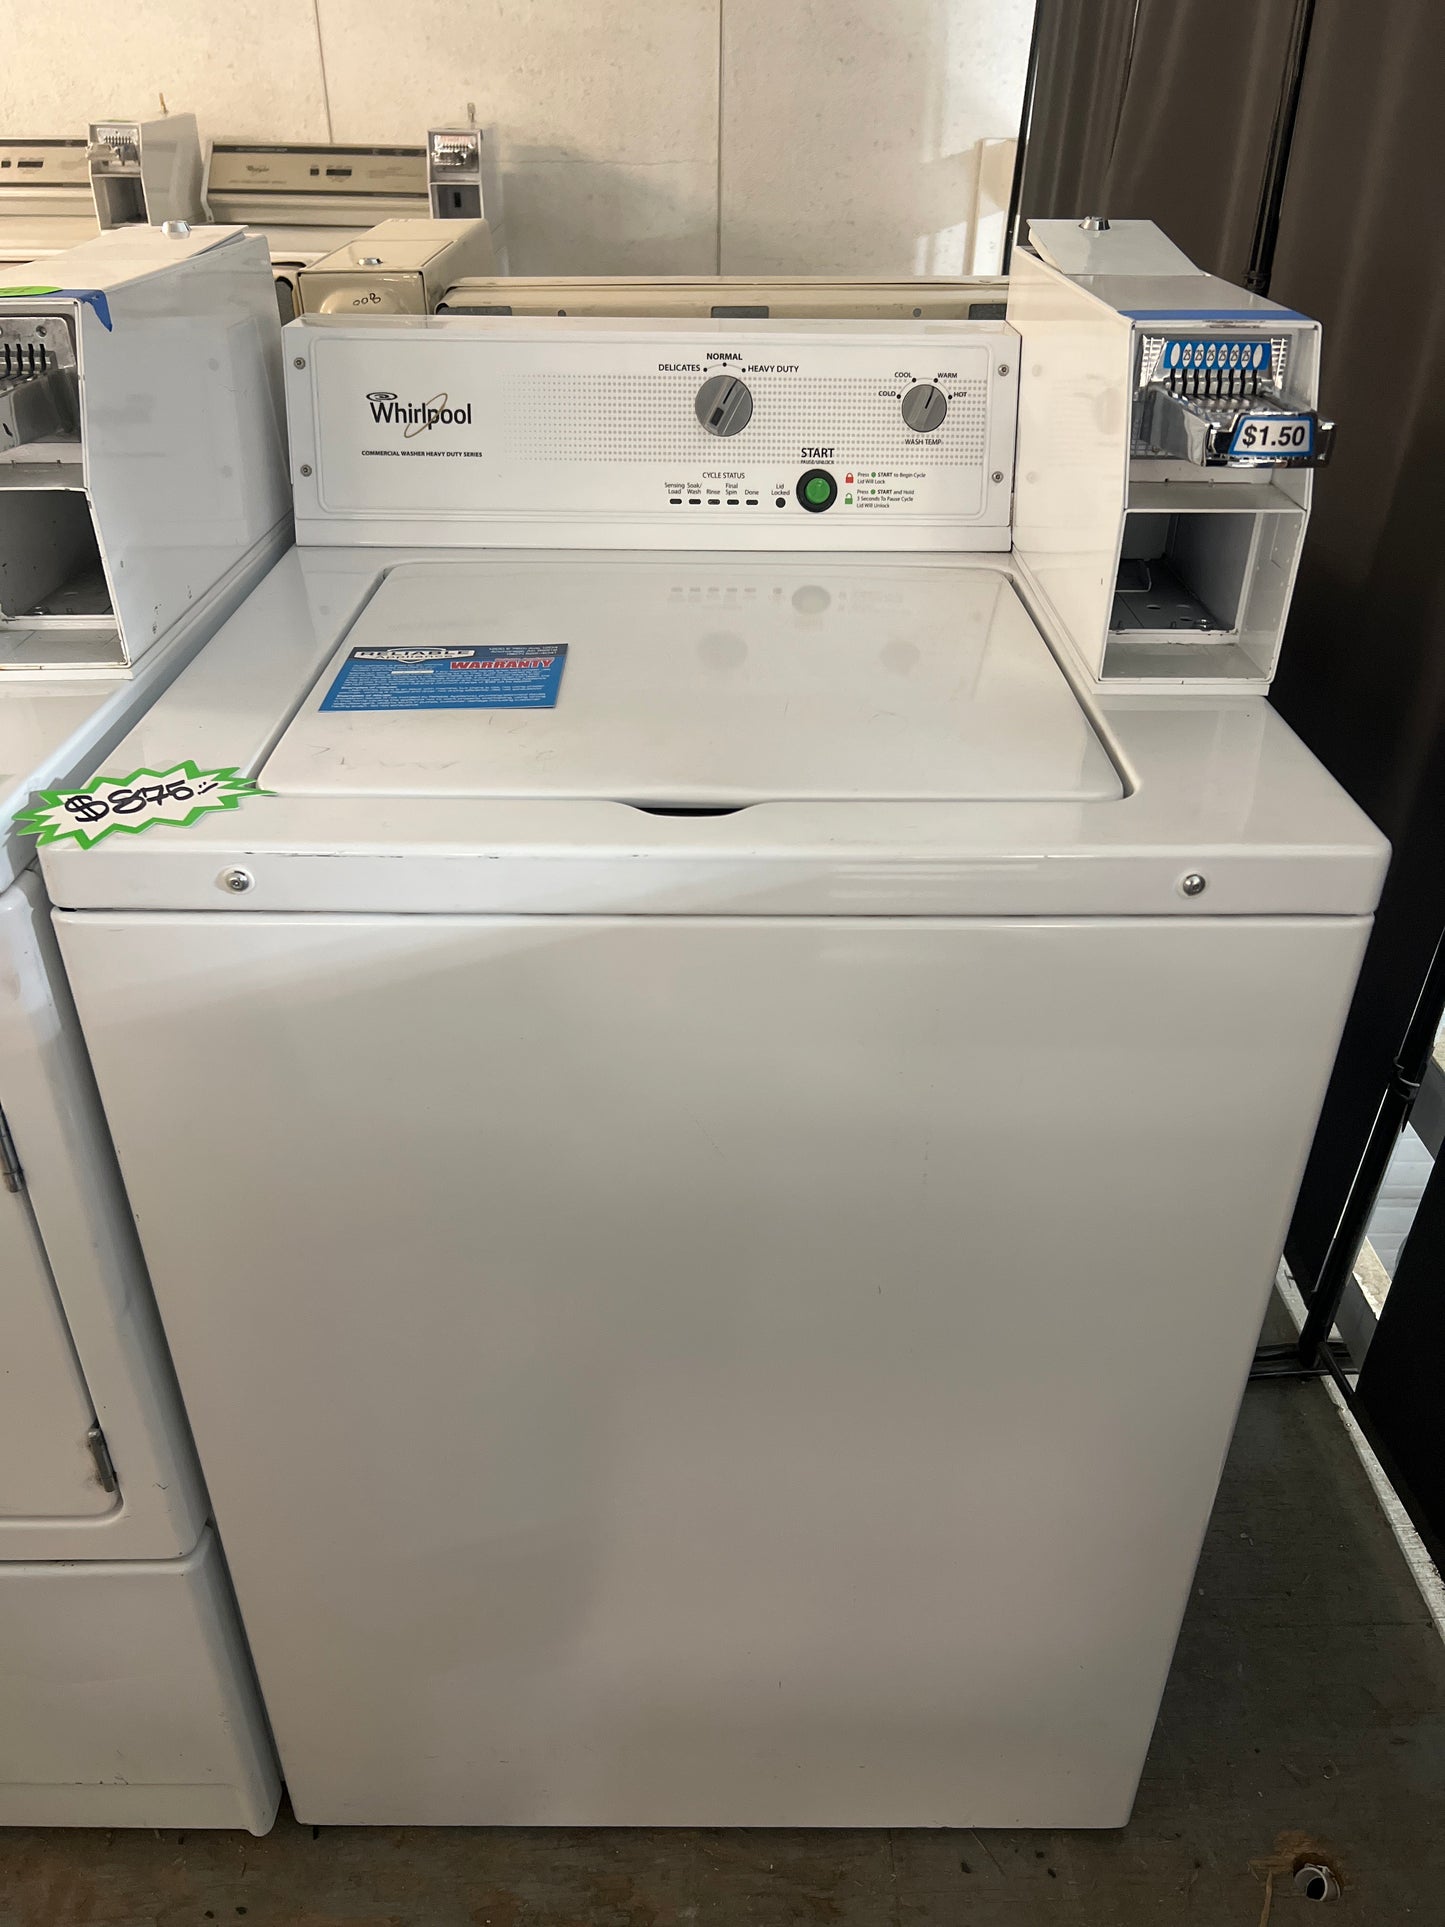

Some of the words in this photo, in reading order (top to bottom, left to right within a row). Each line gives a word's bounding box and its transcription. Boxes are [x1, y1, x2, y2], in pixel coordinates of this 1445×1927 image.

[1183, 349, 1191, 361] 25
[1195, 349, 1203, 361] 25
[1207, 349, 1215, 361] 25
[1218, 349, 1227, 361] 25
[1230, 349, 1238, 361] 25
[1242, 349, 1250, 361] 25
[658, 364, 701, 372] DELICATES
[747, 365, 775, 373] HEAVY
[776, 365, 800, 373] DUTY
[369, 402, 472, 430] Whirlpool
[1242, 424, 1305, 448] $1.50
[801, 447, 835, 458] START
[450, 659, 554, 669] WARRANTY
